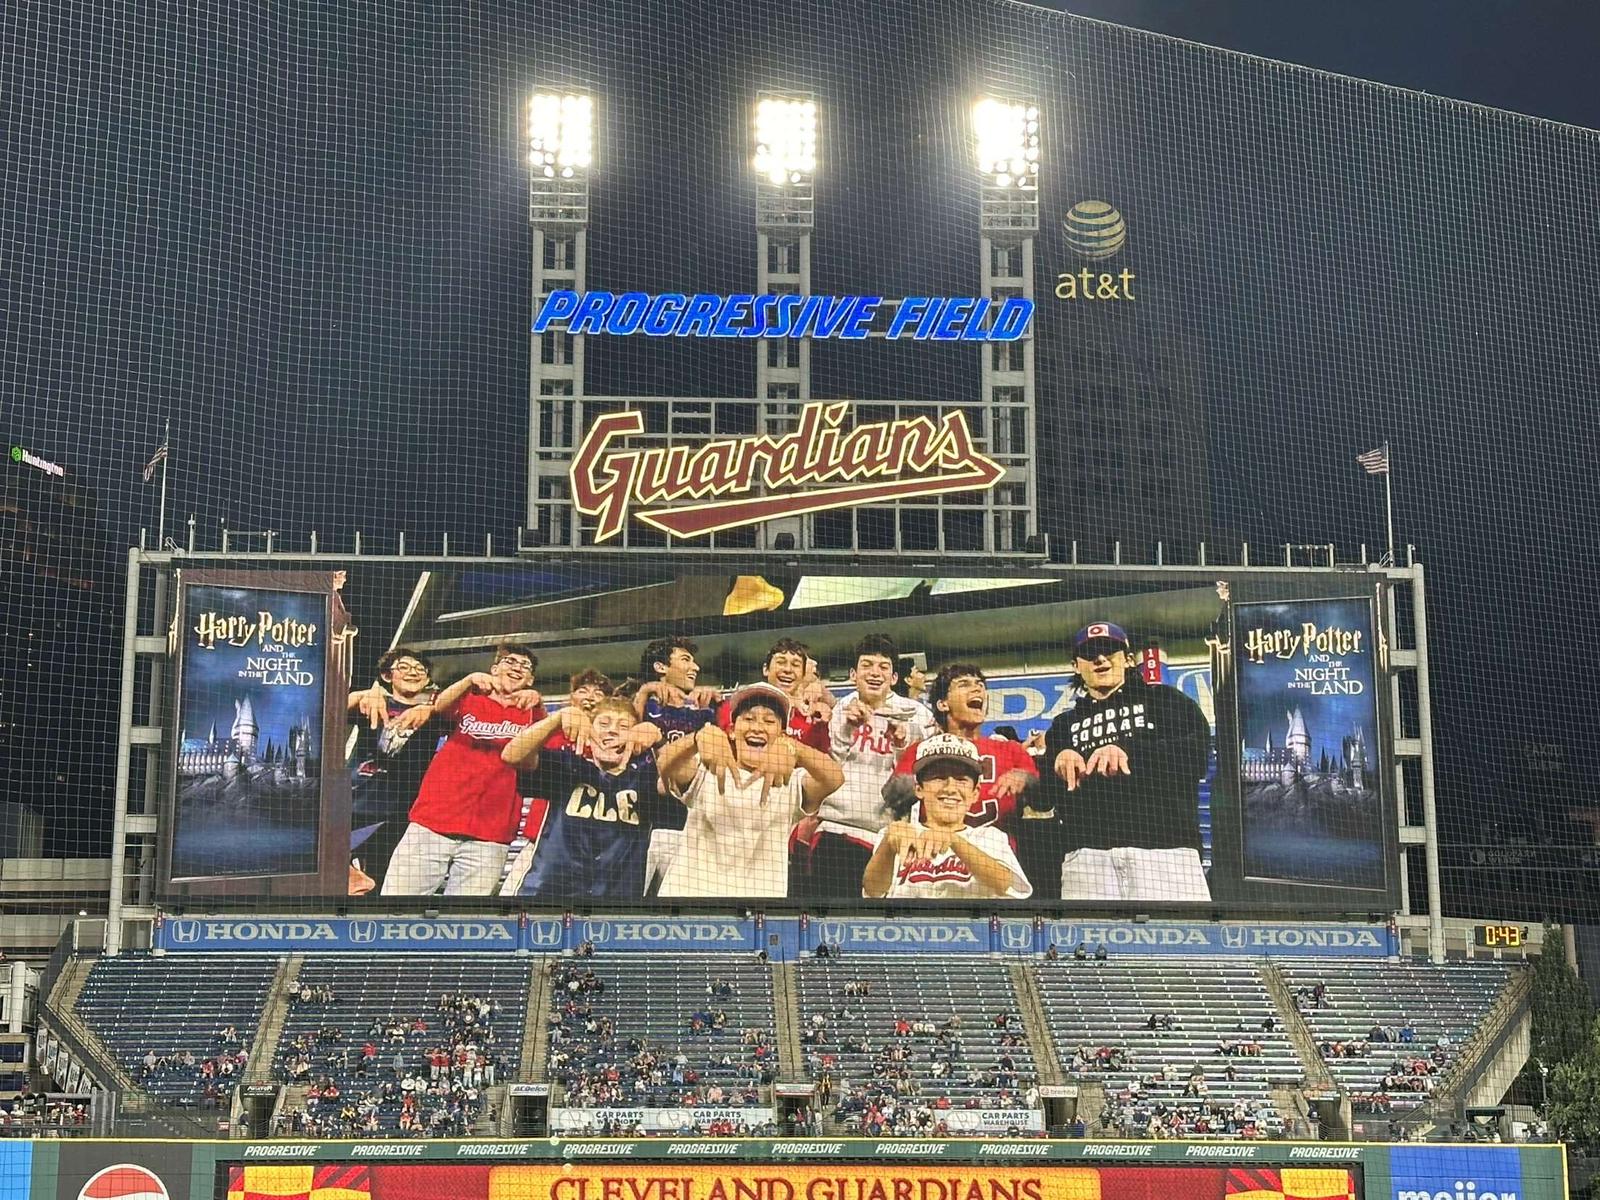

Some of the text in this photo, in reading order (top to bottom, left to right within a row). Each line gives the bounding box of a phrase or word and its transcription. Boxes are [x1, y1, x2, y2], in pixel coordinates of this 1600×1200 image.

[1055, 267, 1136, 300] at&t
[531, 289, 1036, 343] PROGRESSIVE FIELD
[22, 448, 64, 477] Huntington
[569, 401, 1006, 544] Guardians
[194, 611, 317, 650] Harry Potter
[262, 644, 284, 652] AND
[1244, 622, 1362, 664] Harry Potter
[246, 656, 303, 671] NIGHT
[1309, 654, 1330, 662] AND
[262, 671, 314, 686] LAND
[1294, 668, 1350, 681] NIGHT
[1311, 680, 1364, 695] LAND
[1070, 704, 1144, 733] GORDON
[565, 783, 640, 825] CLE
[204, 923, 339, 941] HONDA
[380, 923, 513, 941] HONDA
[614, 924, 745, 941] HONDA
[850, 925, 980, 943] HONDA
[1081, 926, 1211, 945] HONDA
[1251, 929, 1382, 947] HONDA
[1485, 926, 1520, 945] 0:43
[243, 1145, 319, 1156] PROGRESSIVE
[350, 1145, 425, 1156] PROGRESSIVE
[456, 1144, 530, 1155] PROGRESSIVE
[563, 1144, 635, 1155] PROGRESSIVE
[667, 1143, 739, 1154] PROGRESSIVE
[771, 1143, 843, 1154] PROGRESSIVE
[875, 1143, 947, 1154] PROGRESSIVE
[979, 1144, 1050, 1155] PROGRESSIVE
[1082, 1145, 1153, 1156] PROGRESSIVE
[1185, 1146, 1257, 1157] PROGRESSIVE
[1289, 1147, 1361, 1158] PROGRESSIVE
[550, 1177, 1041, 1200] CLEVELAND GUARDIANS
